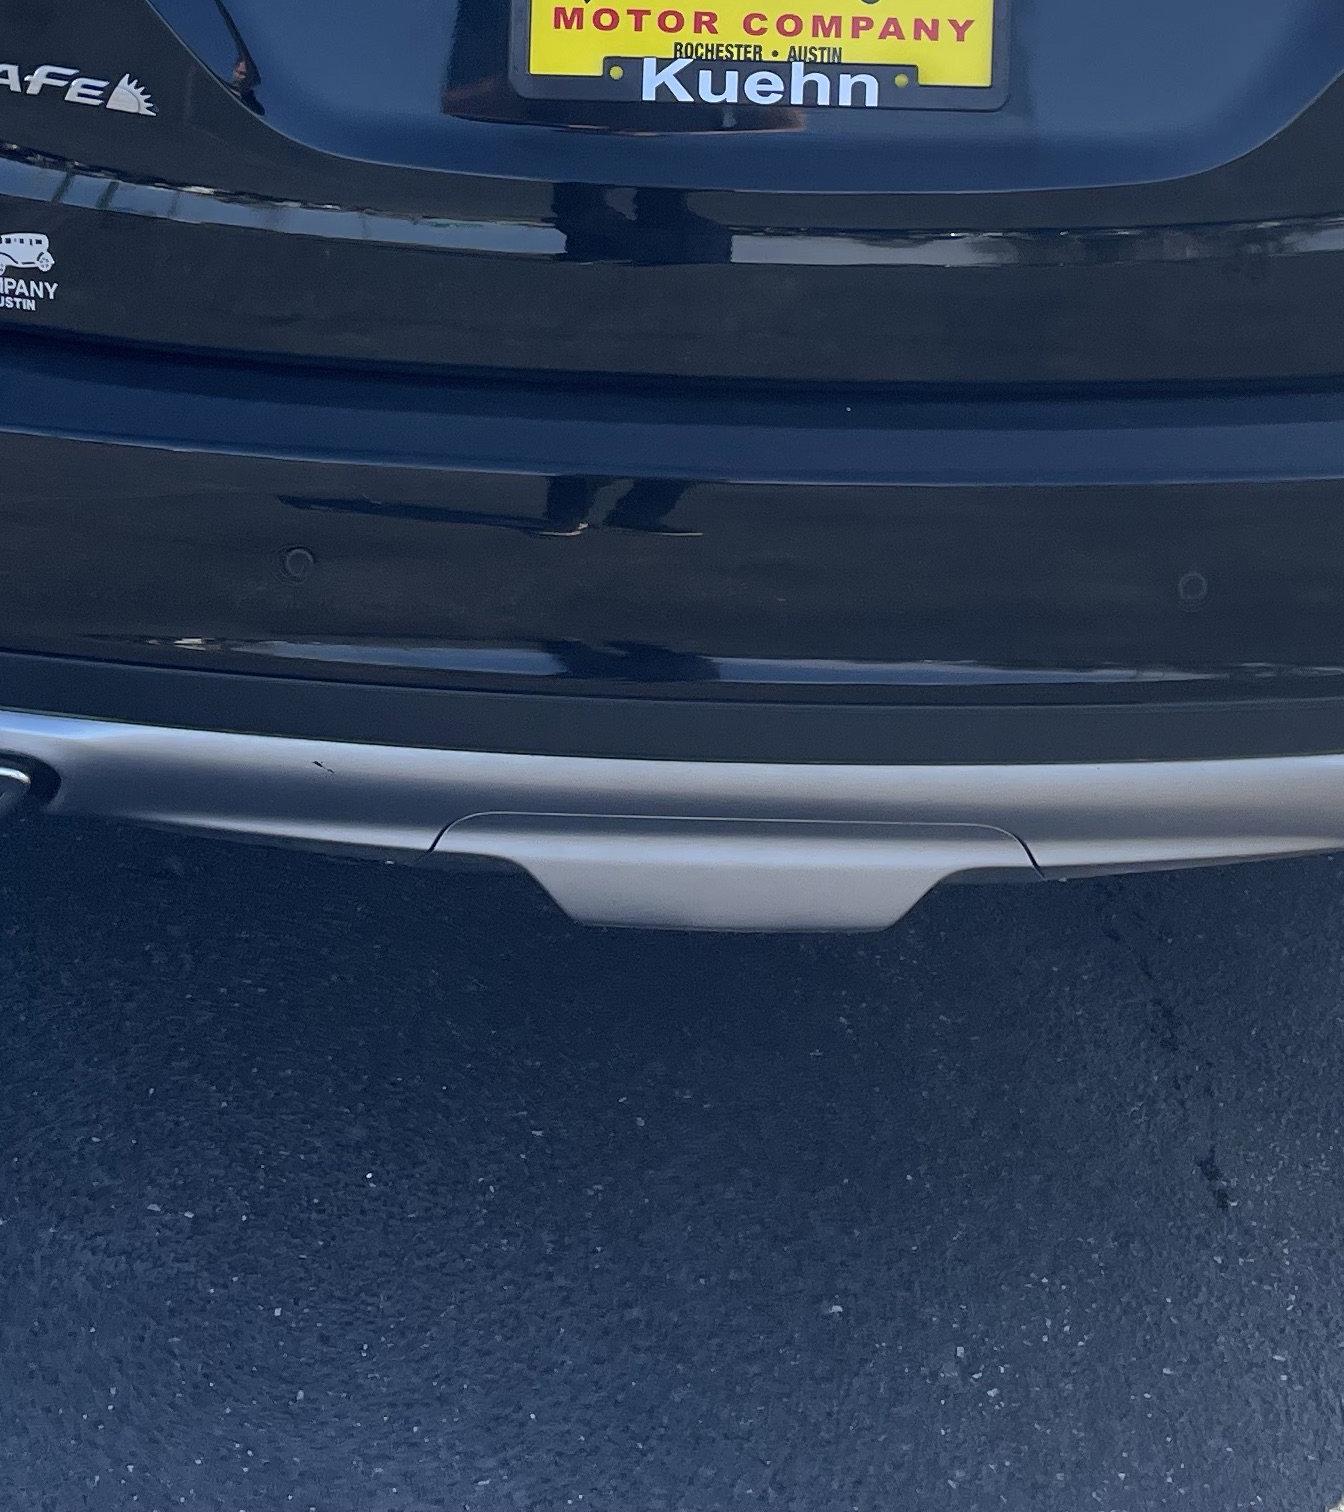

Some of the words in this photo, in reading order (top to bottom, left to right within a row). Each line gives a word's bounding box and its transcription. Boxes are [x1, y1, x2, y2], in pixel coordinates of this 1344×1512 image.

[552, 6, 719, 35] MOTOR
[742, 12, 976, 43] COMPANY
[673, 41, 763, 62] ROCHESTER
[787, 45, 843, 64] AUSTIN
[641, 57, 879, 107] Kuehn
